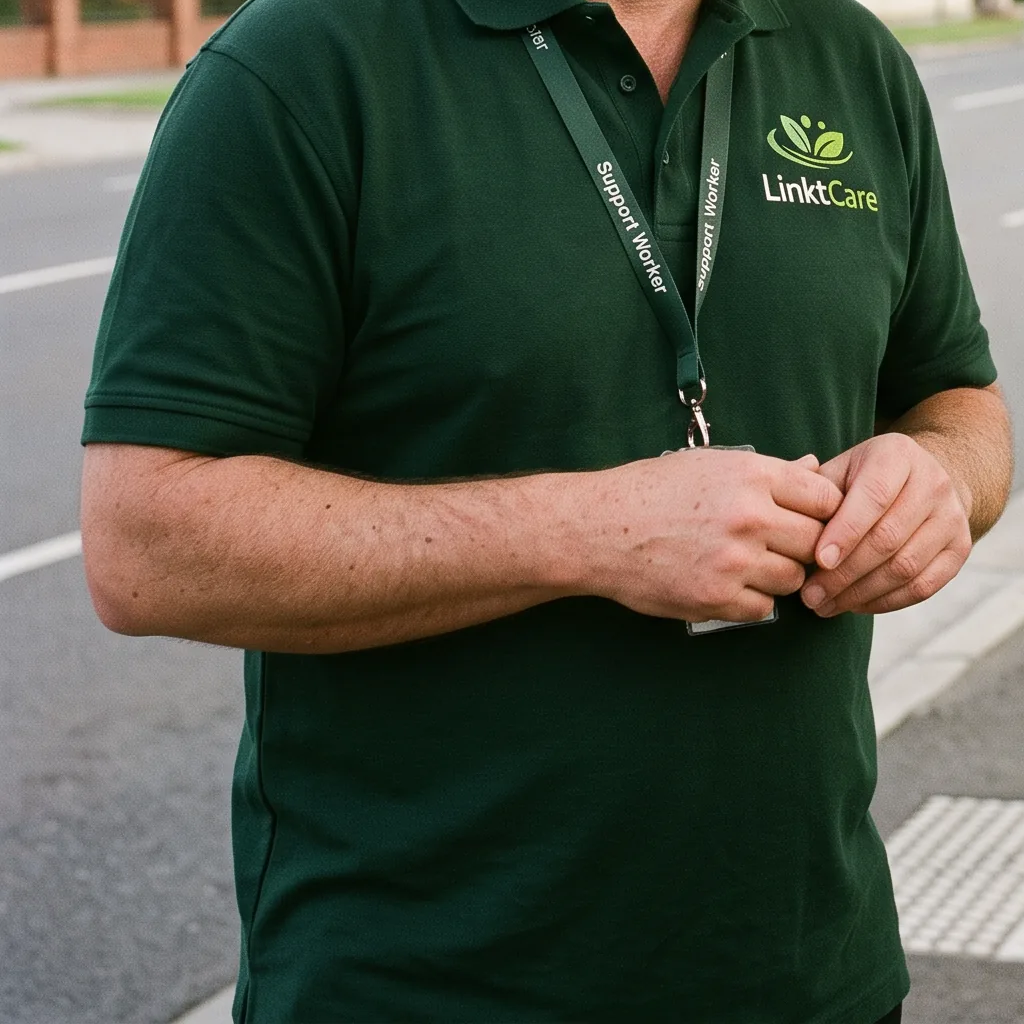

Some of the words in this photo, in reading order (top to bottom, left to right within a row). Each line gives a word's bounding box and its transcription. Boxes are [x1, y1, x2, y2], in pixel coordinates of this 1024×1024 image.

[703, 157, 721, 217] Worker
[762, 173, 879, 212] LinktCare
[596, 160, 640, 232] Support
[632, 231, 668, 293] Worker
